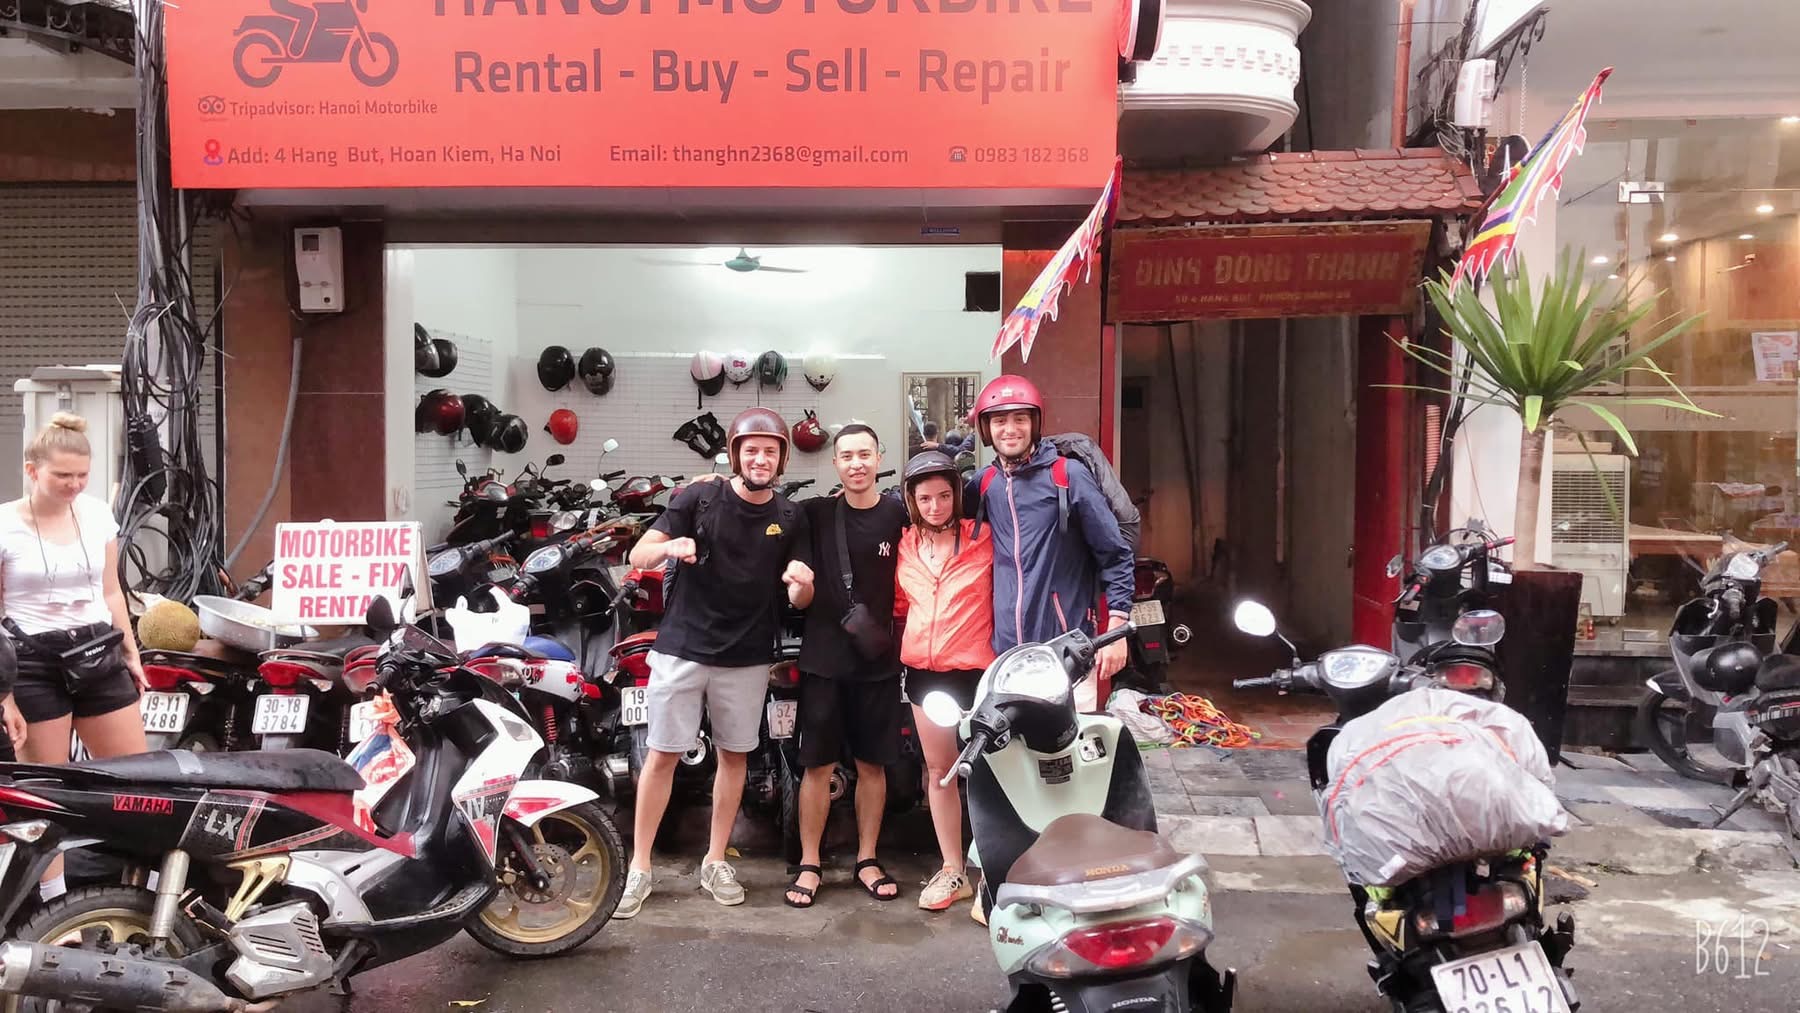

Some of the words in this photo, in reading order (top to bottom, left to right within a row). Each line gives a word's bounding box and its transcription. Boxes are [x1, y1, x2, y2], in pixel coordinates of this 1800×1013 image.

[454, 48, 601, 93] Rental
[652, 48, 738, 104] Buy
[785, 47, 868, 93] Sell
[919, 47, 1071, 105] Repair
[229, 101, 315, 119] Tripadvisor:
[319, 100, 361, 114] Hanoi
[365, 99, 438, 114] Motorbike
[227, 147, 269, 164] Add:
[274, 148, 287, 163] 4
[291, 147, 338, 167] Hang
[347, 146, 385, 165] But,
[391, 146, 437, 162] Hoan
[443, 146, 495, 164] Kiem,
[501, 145, 525, 162] Ha
[531, 144, 561, 161] Noi
[610, 144, 668, 162] Email:
[673, 144, 909, 167] thanghn2368@gmail.com
[975, 147, 1017, 163] 0983
[1022, 147, 1052, 163] 182
[1056, 147, 1089, 163] 368
[279, 527, 412, 558] MOTORBIKE
[281, 563, 343, 589] SALE
[368, 562, 406, 588] FIX
[298, 594, 373, 618] RENTA
[631, 689, 648, 705] 19
[261, 714, 298, 731] 3784
[626, 706, 648, 722] 001
[113, 794, 174, 815] YAMAHA
[203, 808, 243, 841] LX
[1084, 863, 1130, 877] HONDA
[1111, 996, 1159, 1009] HONDA
